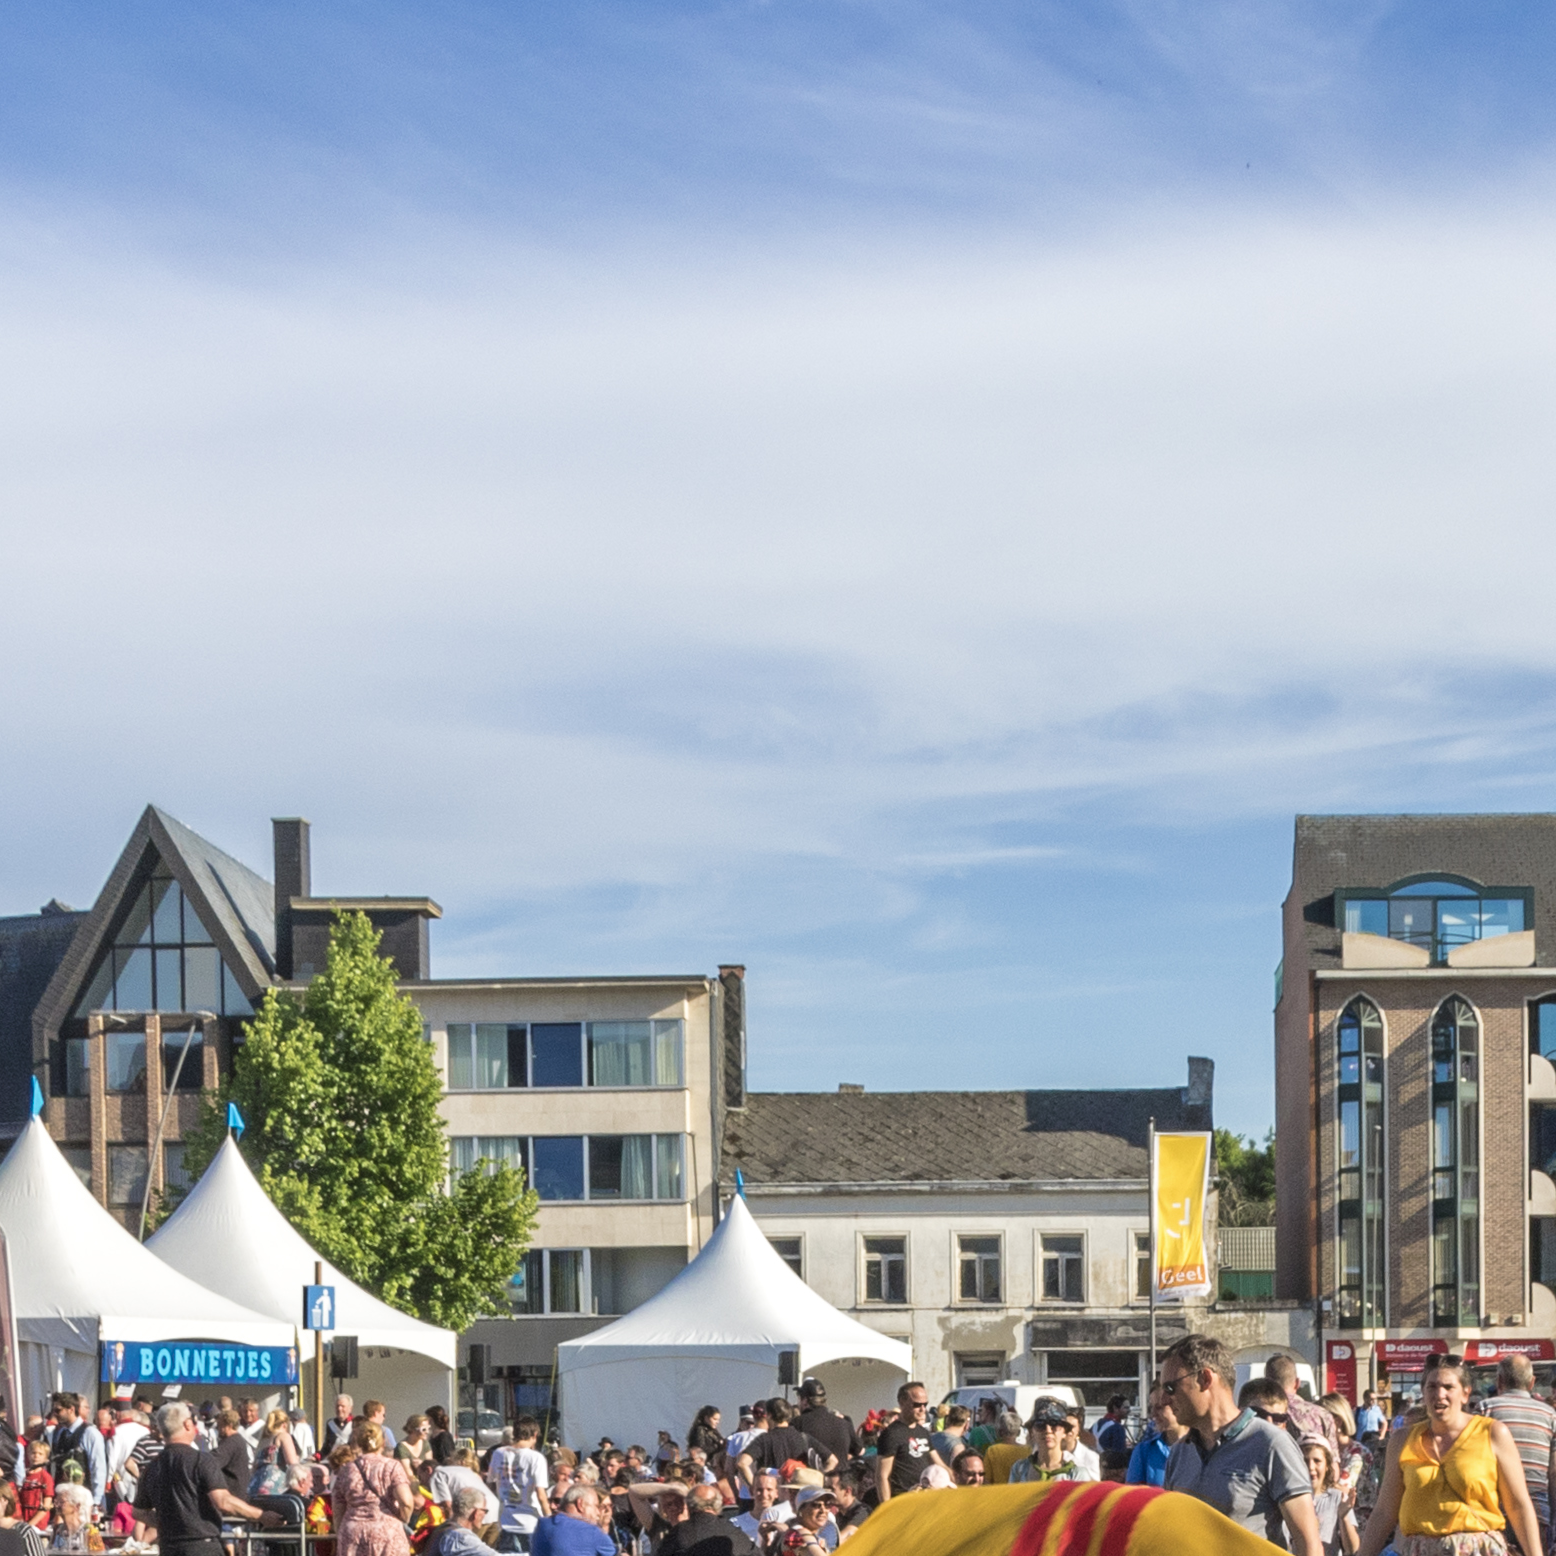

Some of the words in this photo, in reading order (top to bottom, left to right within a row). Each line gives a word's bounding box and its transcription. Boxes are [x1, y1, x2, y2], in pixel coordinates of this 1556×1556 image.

[1161, 1265, 1203, 1285] Geel
[1397, 1344, 1434, 1352] daoust
[1498, 1343, 1541, 1353] daoust
[140, 1347, 272, 1378] BONNETJES
